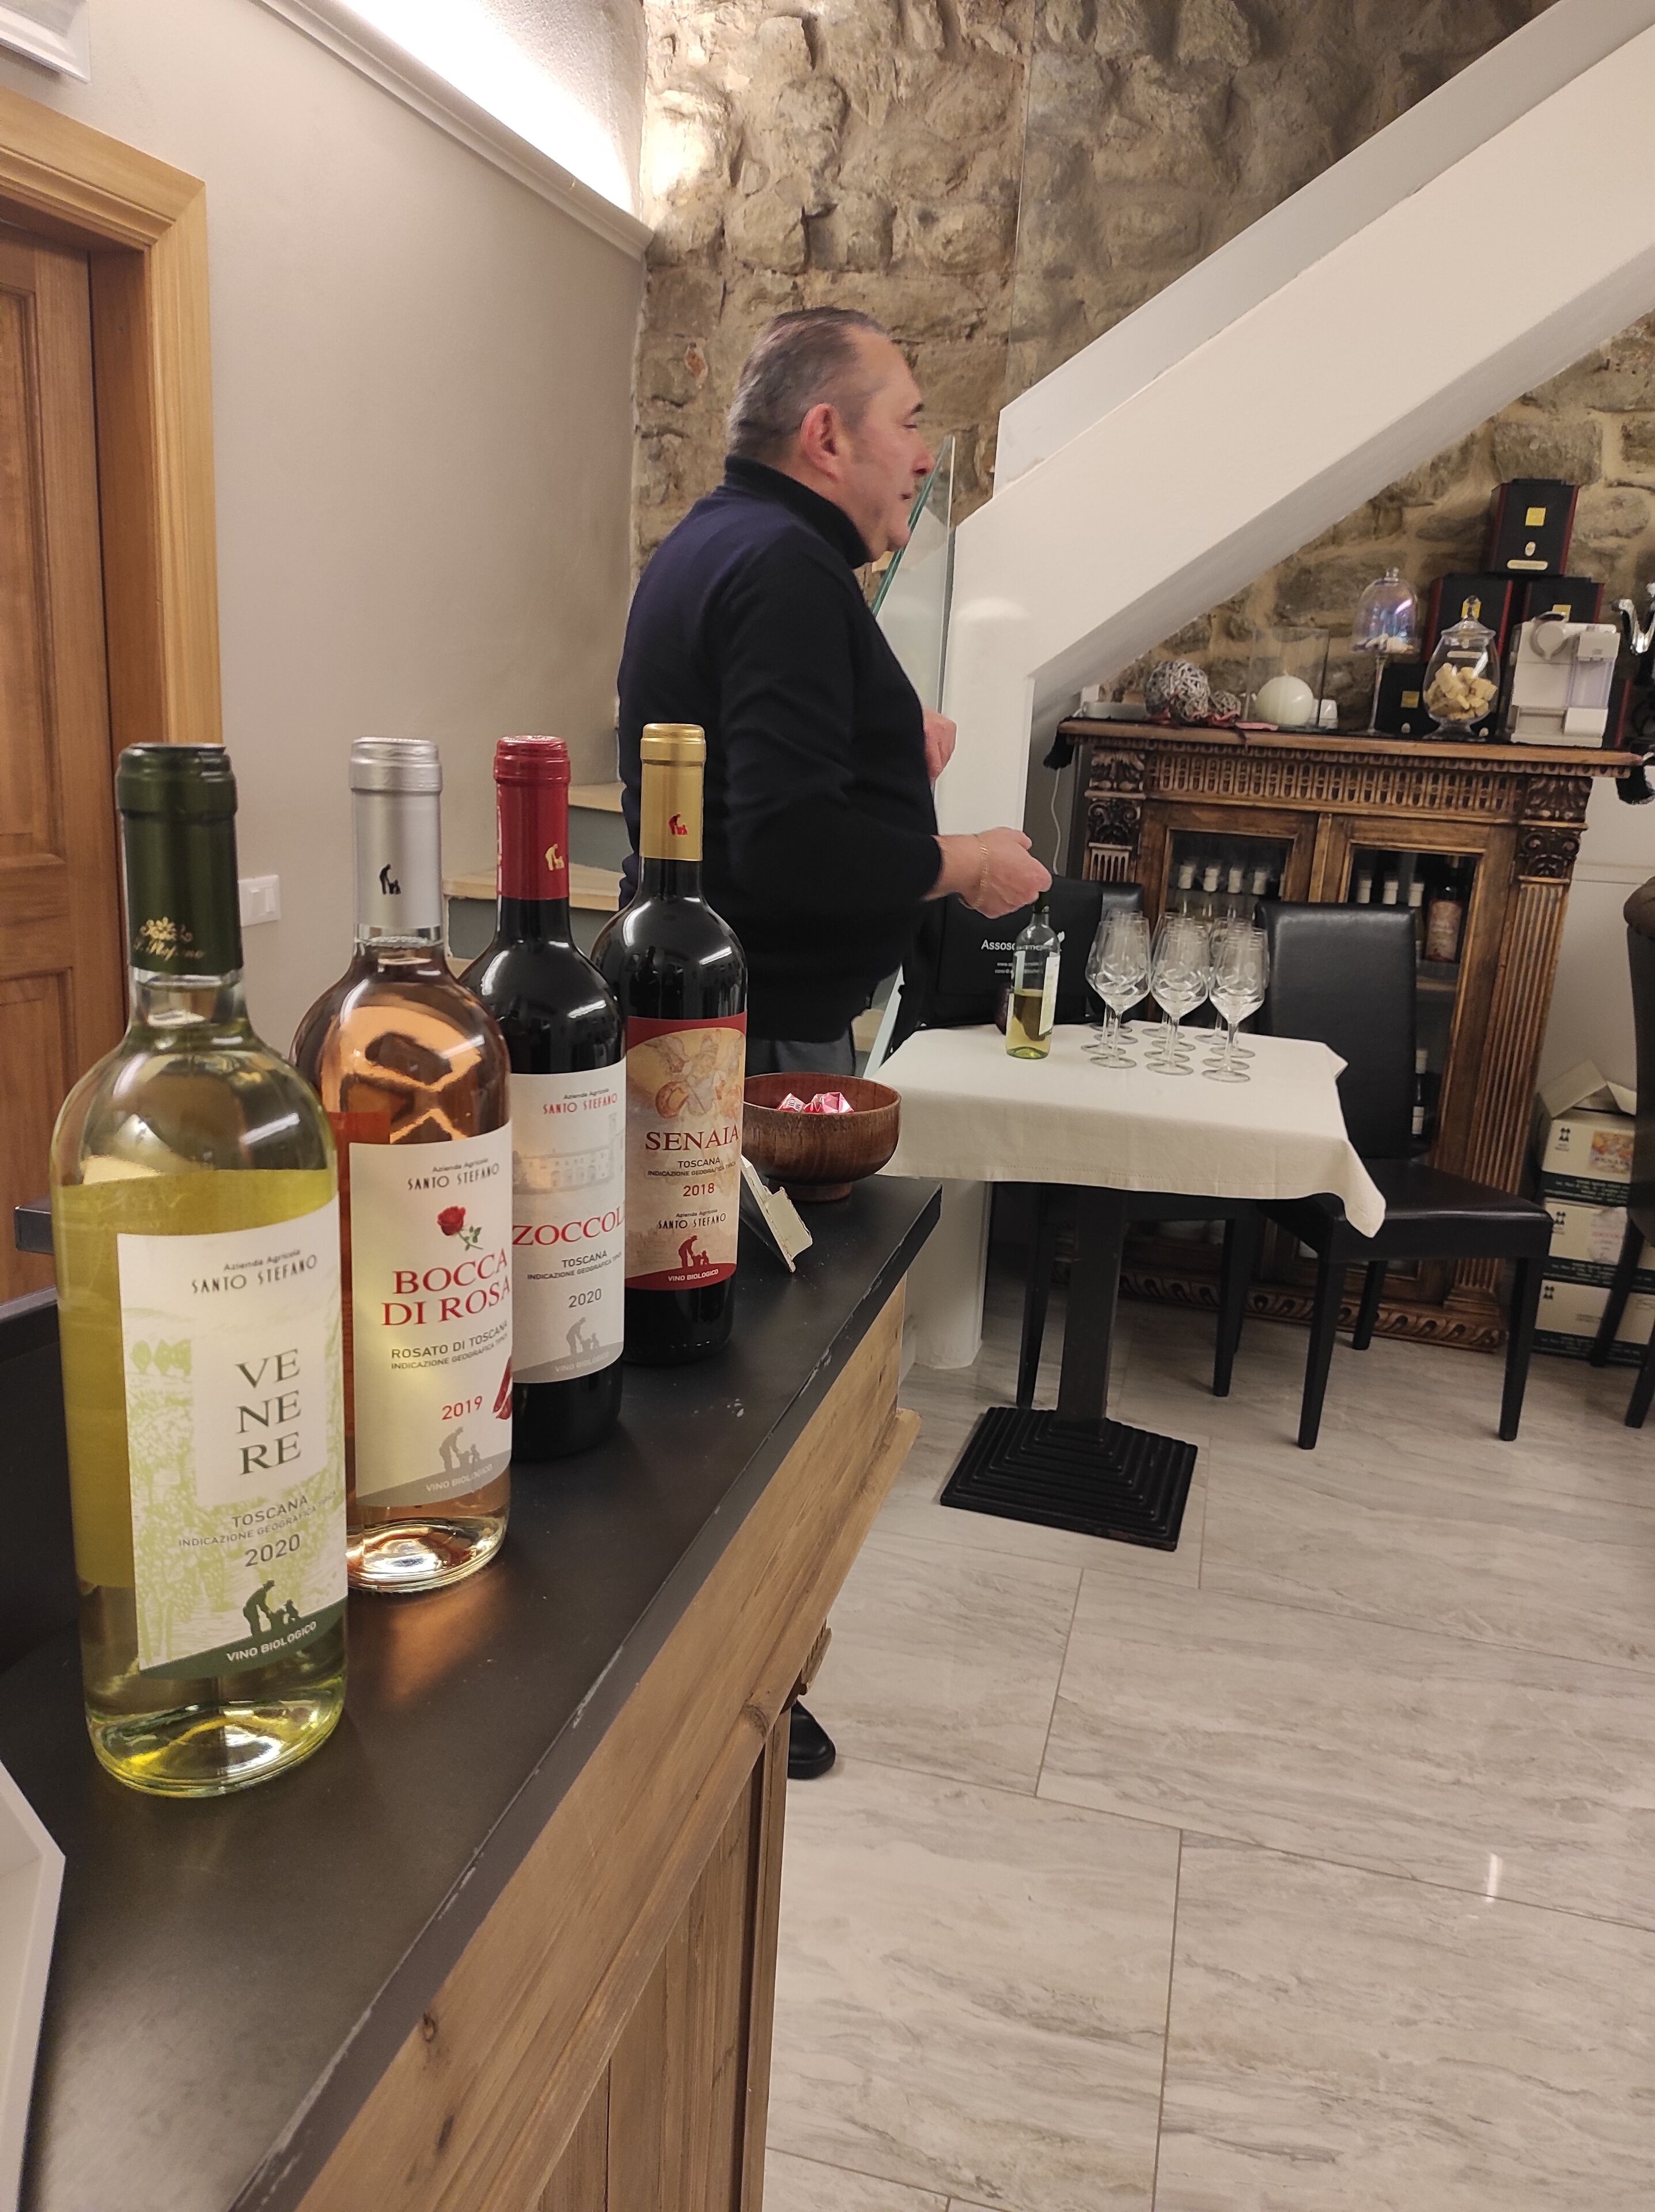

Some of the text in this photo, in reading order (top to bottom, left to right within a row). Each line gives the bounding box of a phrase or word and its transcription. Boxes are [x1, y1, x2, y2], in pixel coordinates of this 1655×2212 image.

[543, 1093, 618, 1115] SANTO STEFANO
[645, 1124, 739, 1151] SENAIA
[677, 1157, 721, 1169] TOSCANA
[691, 1166, 725, 1176] GEOGRAFICA
[407, 1163, 499, 1191] SANTO STEFANO
[683, 1183, 715, 1198] 2018
[658, 1213, 726, 1230] SANTO STEFANO
[224, 1259, 263, 1271] Azienda
[392, 1248, 508, 1294] BOCCA
[527, 1259, 612, 1280] INDICAZIONE GEOGRAFICA
[562, 1250, 607, 1268] TOSCANA
[192, 1254, 317, 1294] SANTO STEFANO
[687, 1268, 719, 1281] BIOLOGICO
[381, 1275, 510, 1325] DI ROSA
[568, 1288, 602, 1308] 2020
[391, 1344, 448, 1359] ROSATO
[453, 1340, 465, 1352] DI
[391, 1343, 495, 1370] INDICAZIONE GEOGRAFICA
[235, 1349, 300, 1388] VE
[236, 1389, 301, 1434] NE
[441, 1395, 483, 1421] 2019
[239, 1431, 301, 1475] RE
[426, 1480, 449, 1491] VINO
[232, 1495, 309, 1528] TOSCANA
[178, 1506, 316, 1547] INDICAZIONE GEOGRAFICA
[244, 1533, 301, 1567] 2020
[226, 1620, 317, 1662] VINO BIOLOGICO
